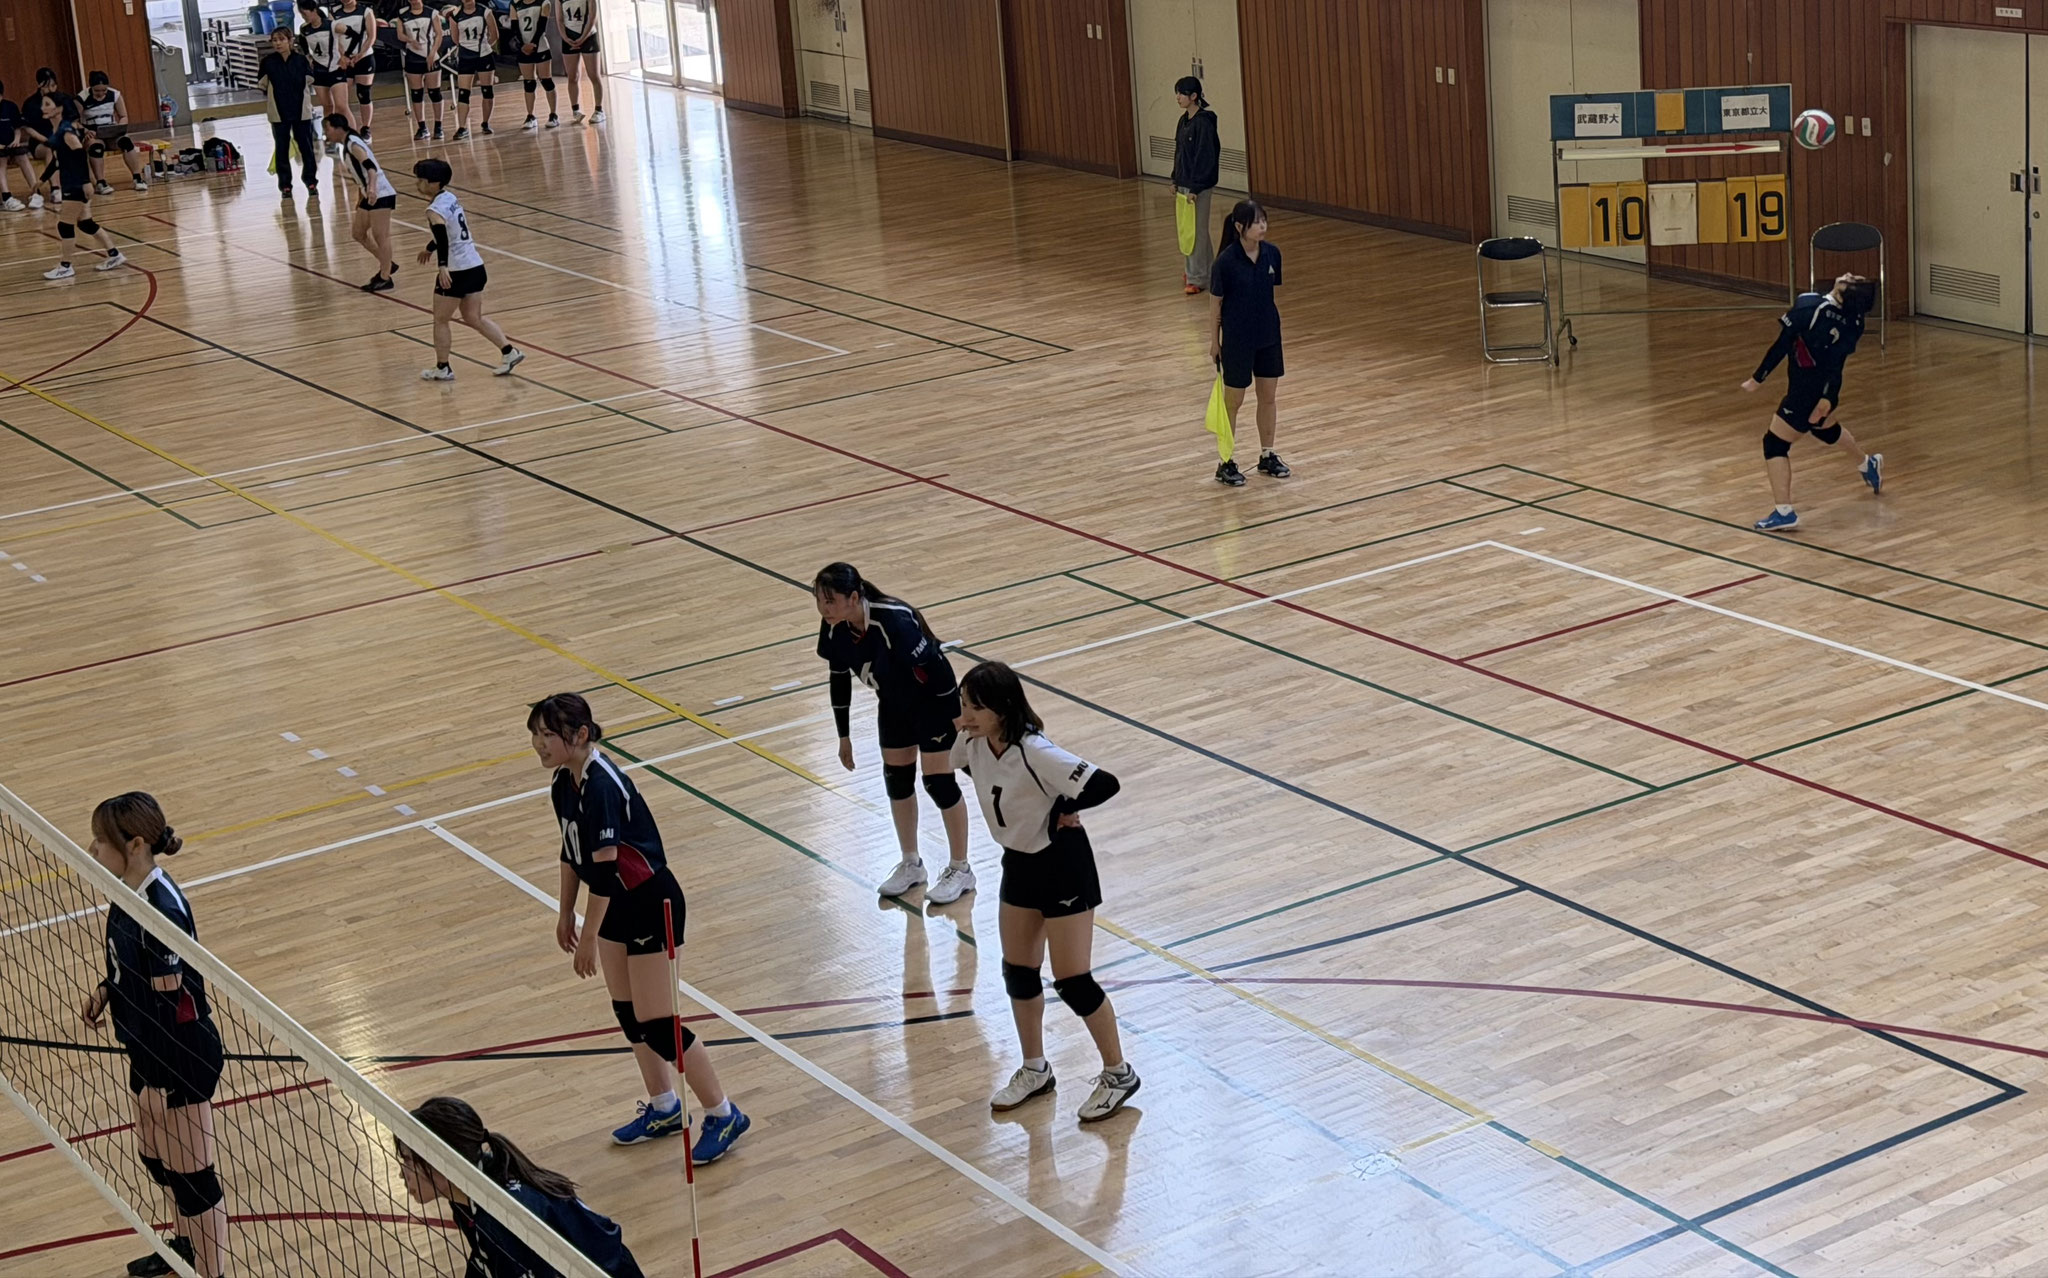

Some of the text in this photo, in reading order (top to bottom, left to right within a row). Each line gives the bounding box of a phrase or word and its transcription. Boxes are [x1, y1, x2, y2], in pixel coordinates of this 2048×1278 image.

[523, 16, 533, 32] 2
[566, 7, 582, 22] 14
[412, 27, 421, 42] 7
[464, 26, 478, 40] 11
[314, 42, 323, 56] 4
[1577, 113, 1620, 125] 武蔵野大
[1723, 106, 1768, 117] 東京都立大
[1595, 196, 1645, 242] 10
[1733, 190, 1785, 237] 19
[457, 212, 470, 241] 8
[911, 636, 928, 658] TMU
[1068, 760, 1089, 783] TMU
[990, 785, 1007, 828] 1
[561, 817, 582, 866] 10
